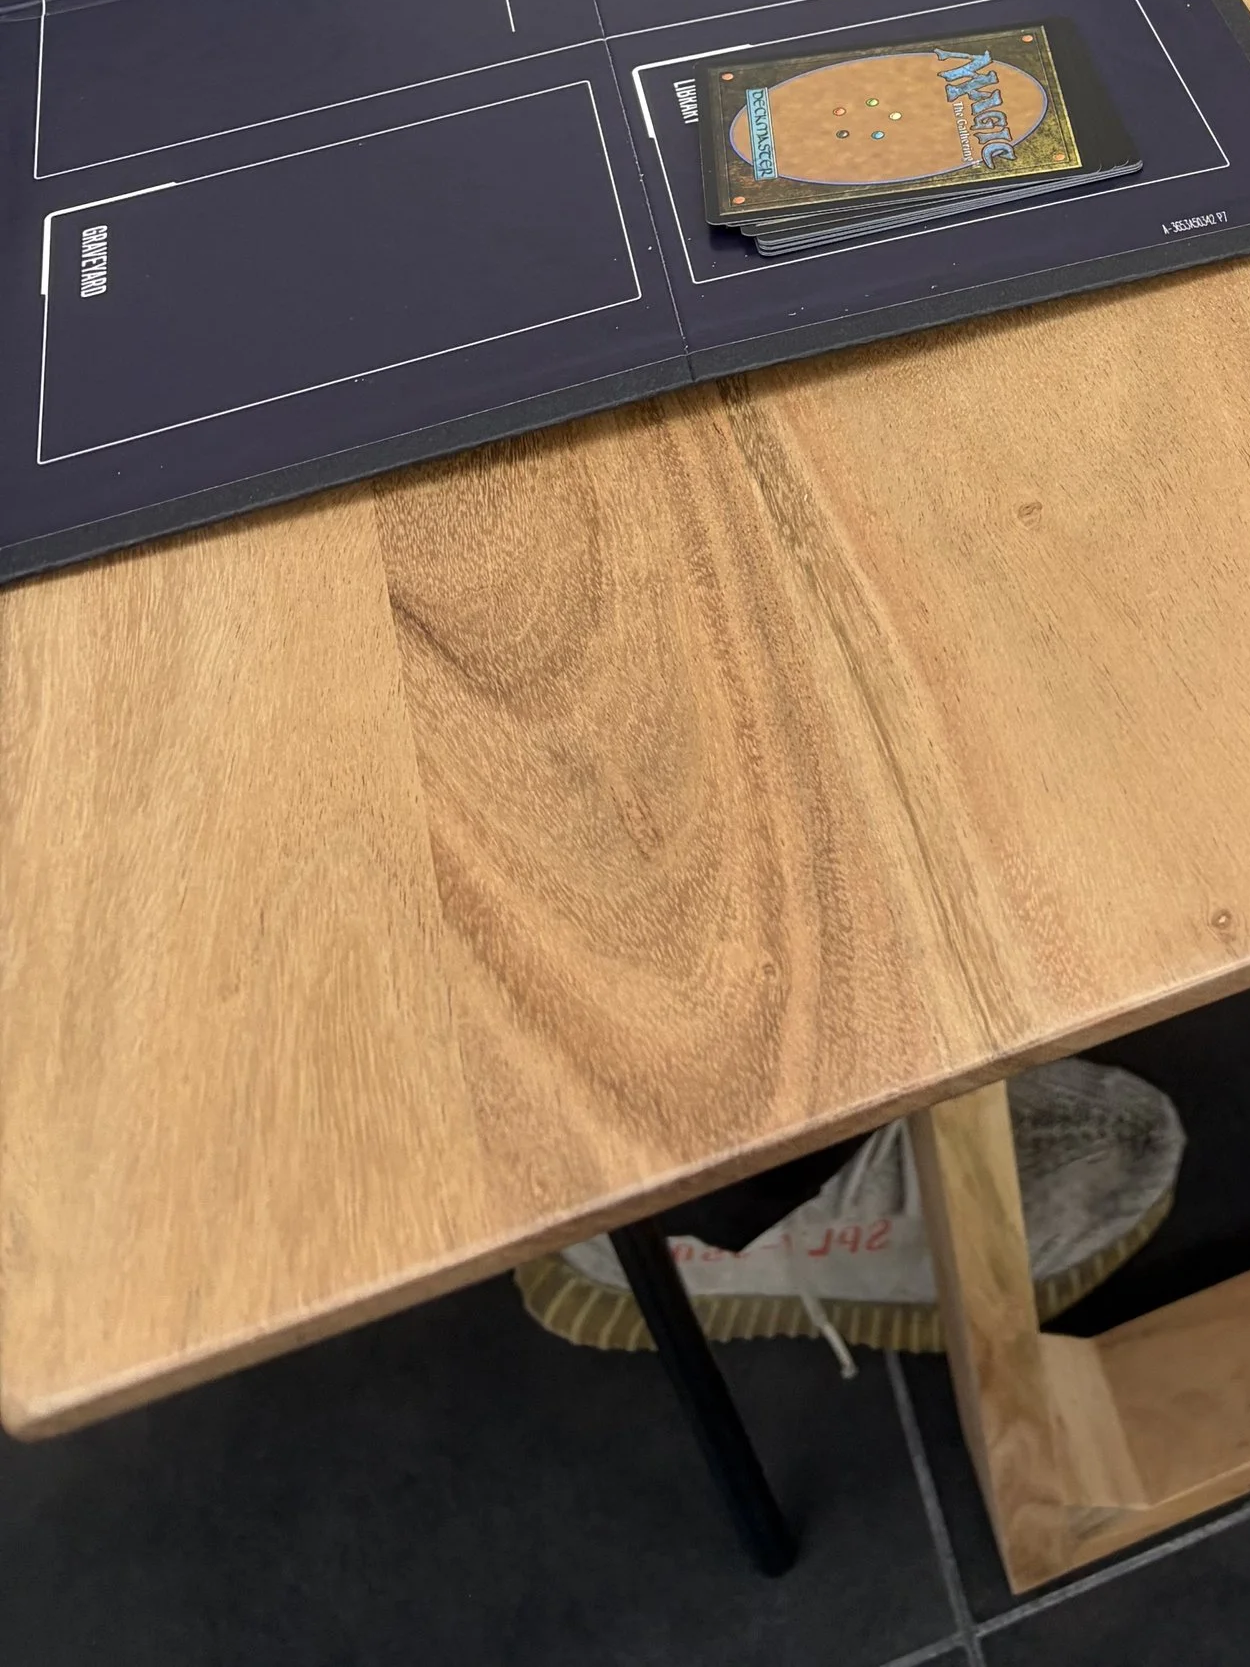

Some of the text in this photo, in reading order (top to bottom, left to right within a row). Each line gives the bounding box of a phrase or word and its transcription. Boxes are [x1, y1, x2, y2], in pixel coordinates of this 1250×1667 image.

[752, 89, 775, 178] DECKMASTER
[953, 101, 974, 162] The Gathering
[81, 224, 108, 298] GRAVEYARD
